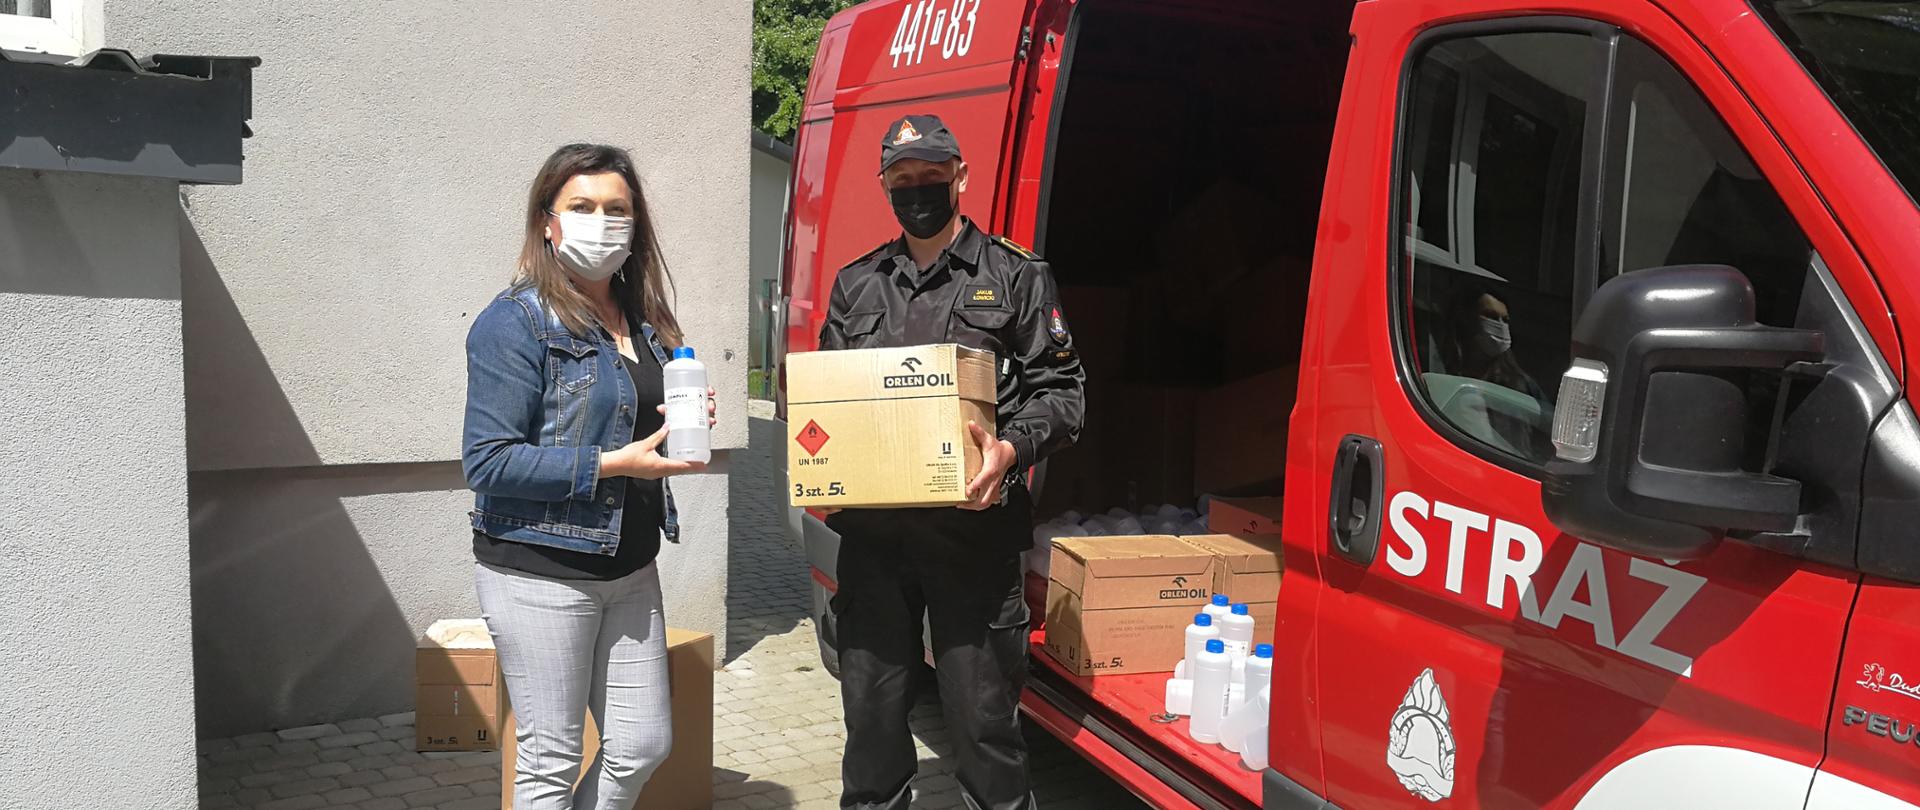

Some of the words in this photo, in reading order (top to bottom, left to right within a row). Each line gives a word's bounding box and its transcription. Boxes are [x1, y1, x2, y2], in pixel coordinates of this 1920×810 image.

[884, 375, 924, 388] ORLEN
[926, 373, 954, 387] OIL
[798, 458, 810, 466] UN
[812, 457, 829, 465] 1987
[795, 483, 804, 497] 3
[806, 487, 824, 497] szt.
[1385, 490, 1709, 678] STRAŻ
[1160, 589, 1188, 599] ORLEN
[1190, 589, 1207, 598] OIL
[1084, 659, 1091, 669] 3
[1093, 661, 1108, 669] szt.
